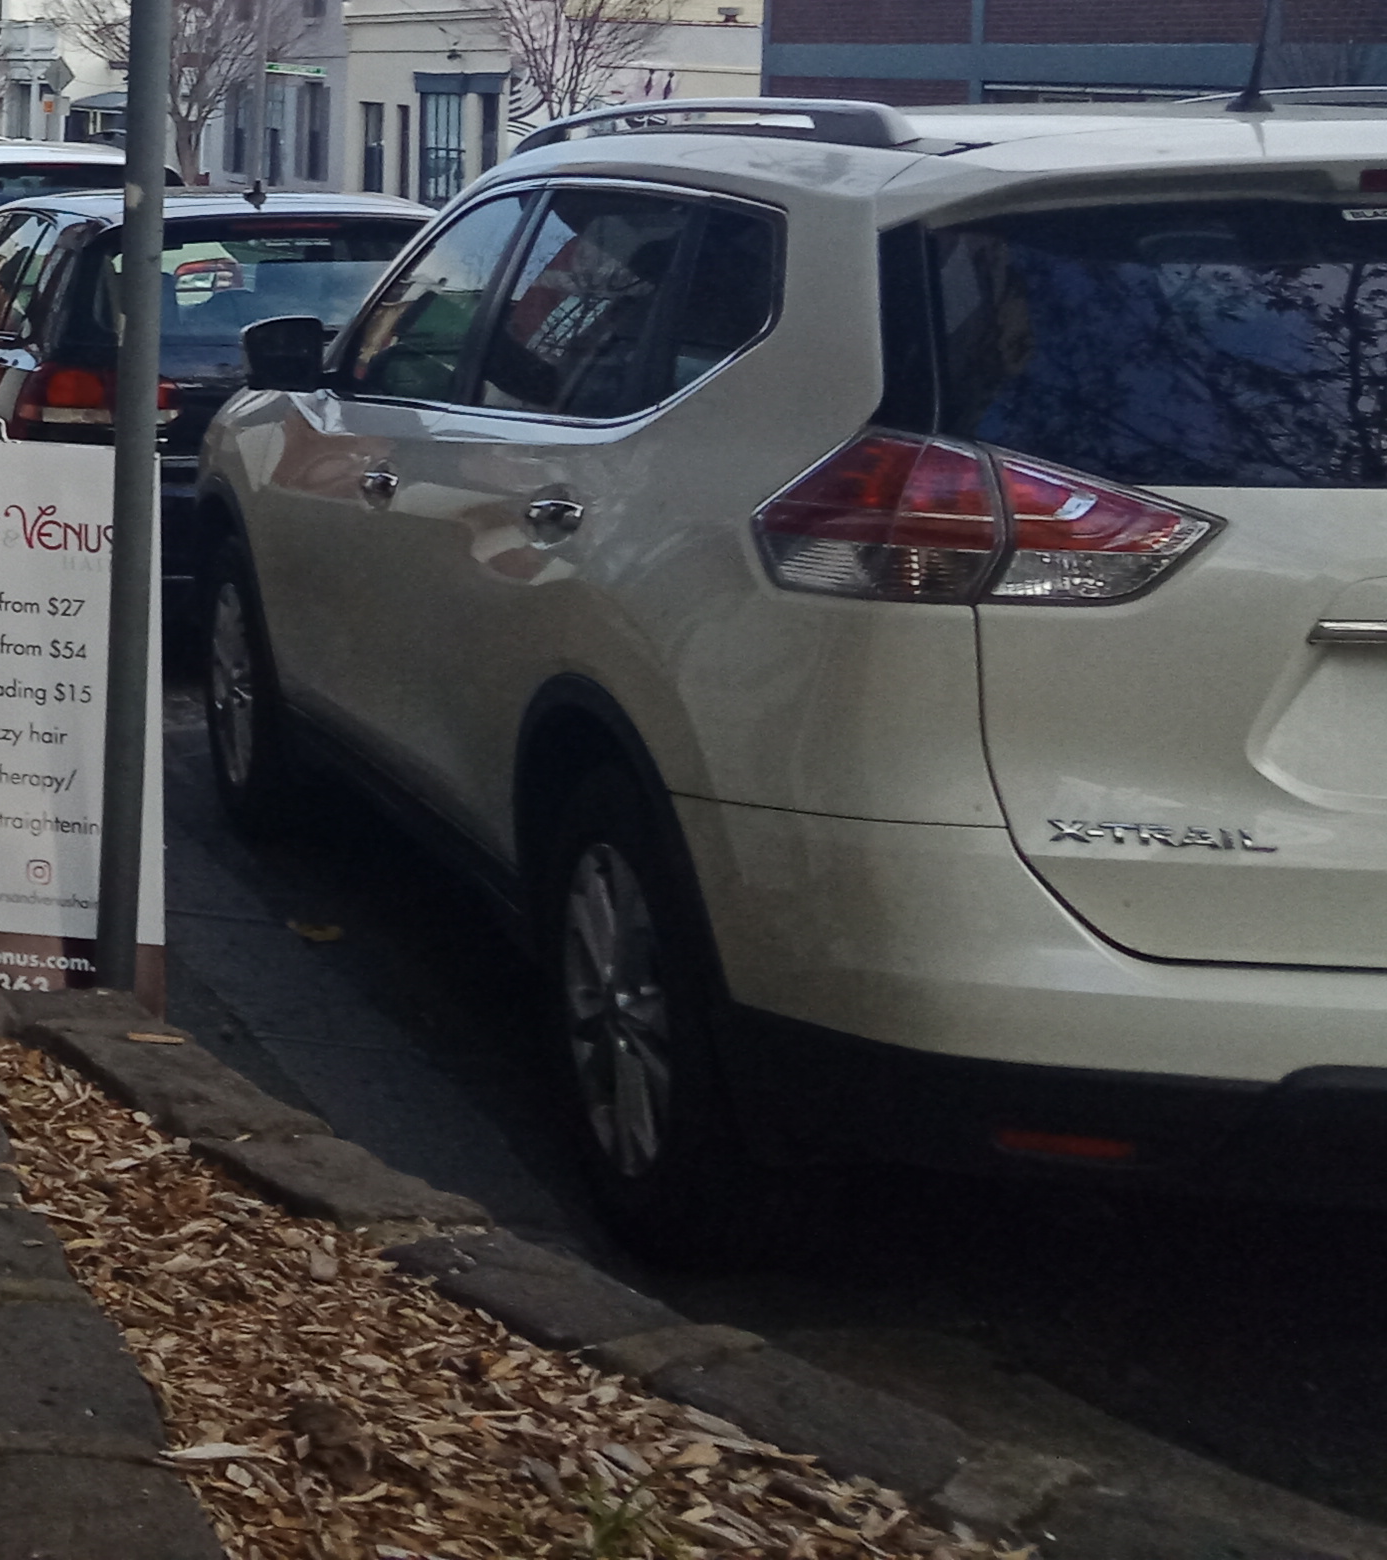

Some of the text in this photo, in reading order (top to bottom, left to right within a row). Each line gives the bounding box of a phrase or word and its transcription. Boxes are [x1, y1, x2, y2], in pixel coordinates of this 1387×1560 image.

[46, 596, 86, 618] $27
[0, 633, 43, 657] from
[48, 638, 88, 660] $54
[53, 682, 93, 704] $15
[28, 721, 69, 745] hair
[1046, 818, 1279, 853] X-TRAIL
